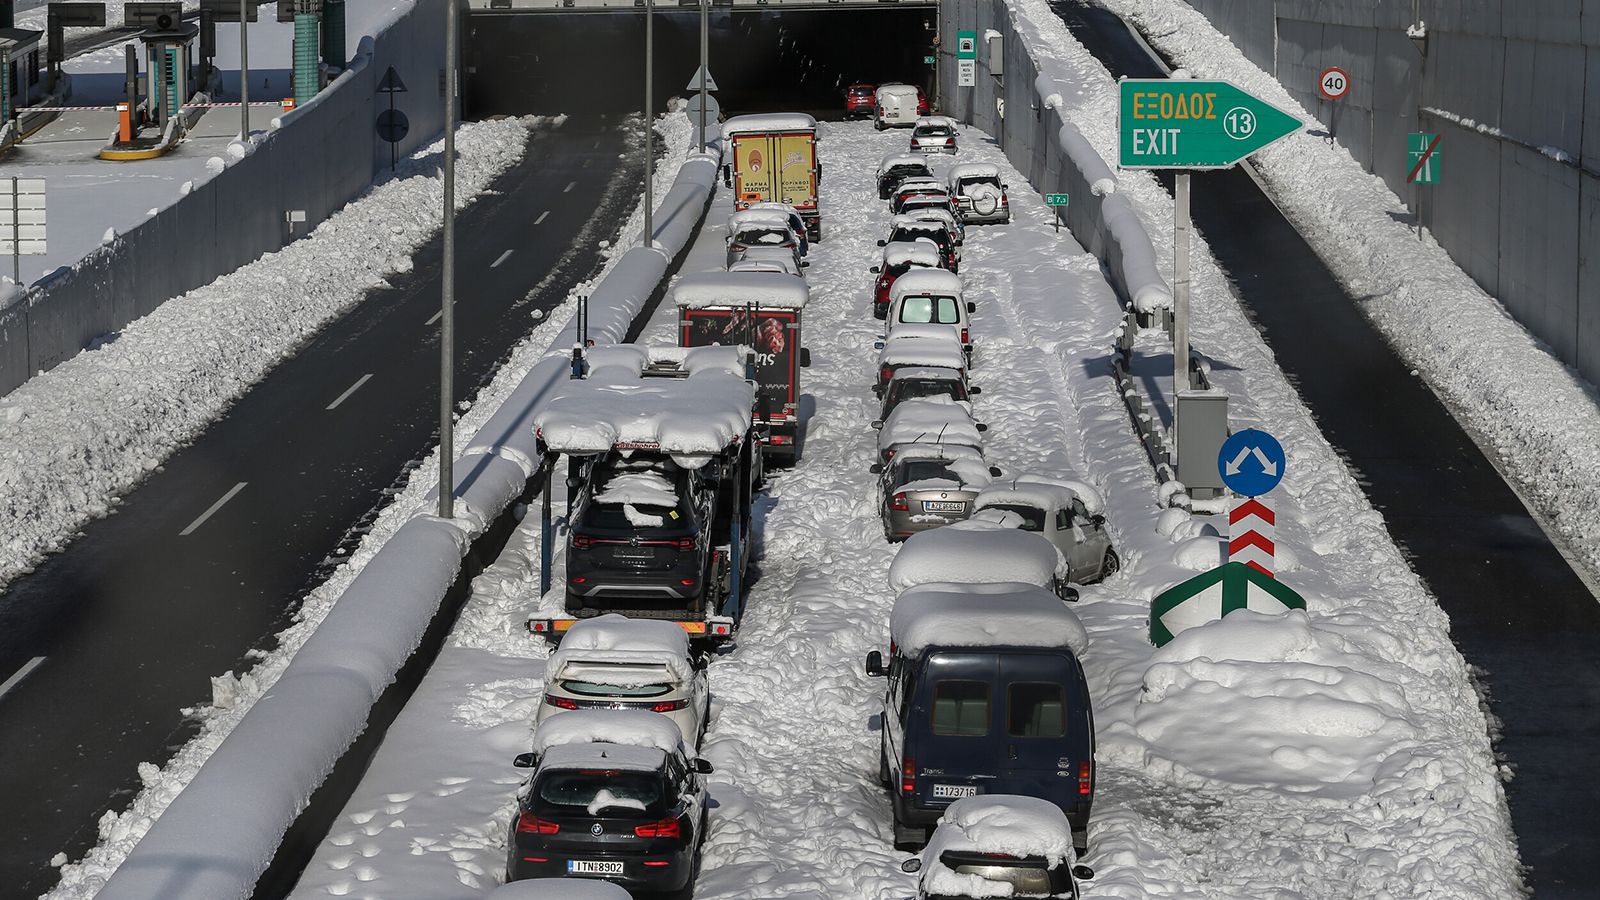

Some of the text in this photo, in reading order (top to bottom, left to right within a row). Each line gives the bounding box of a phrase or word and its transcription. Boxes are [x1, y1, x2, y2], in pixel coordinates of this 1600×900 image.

[1324, 77, 1343, 90] 40
[1133, 92, 1217, 119] ΕΞΟΔΟΣ
[1228, 113, 1252, 134] 13
[1133, 128, 1181, 155] EXIT
[944, 786, 976, 797] 173716
